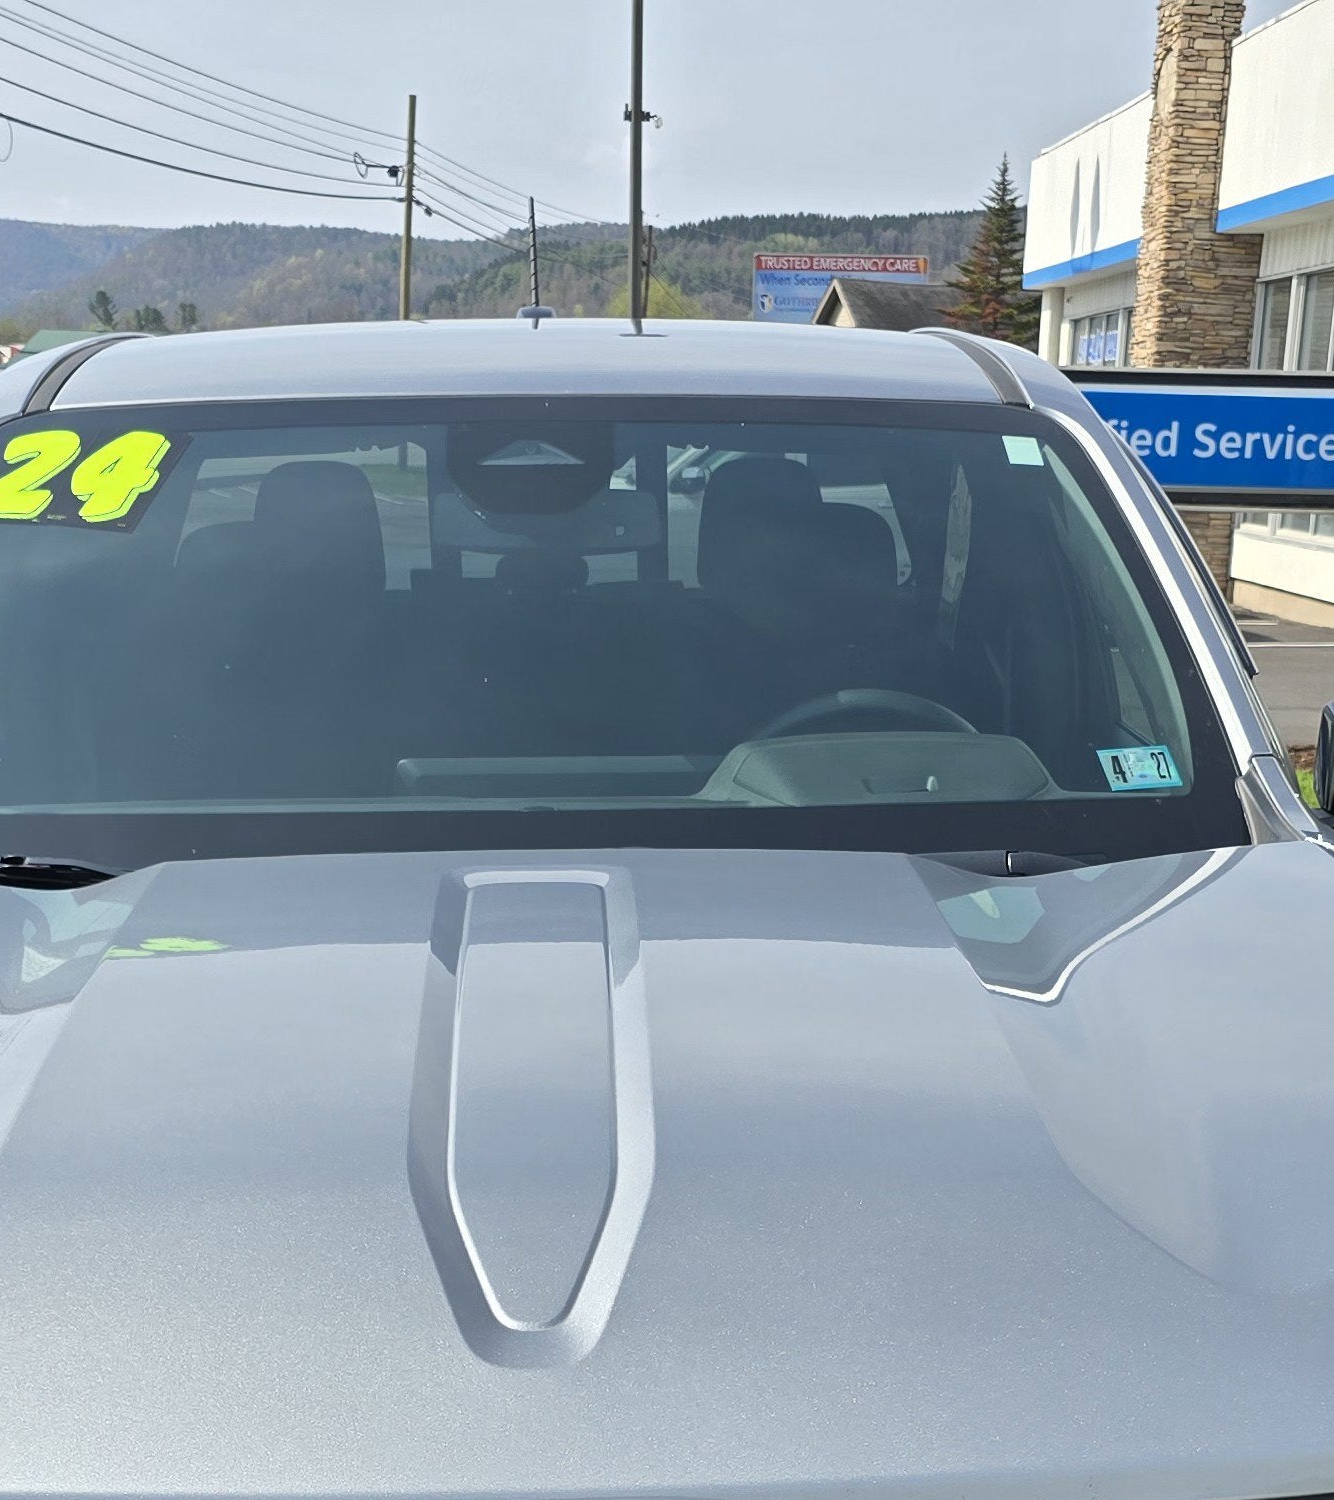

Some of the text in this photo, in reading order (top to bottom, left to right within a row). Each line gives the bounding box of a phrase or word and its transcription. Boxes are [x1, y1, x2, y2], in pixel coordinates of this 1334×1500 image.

[760, 256, 917, 272] TRUSTED EMERGENCY CARE
[759, 272, 791, 285] When
[1110, 755, 1129, 784] 4
[1150, 751, 1172, 781] 27
